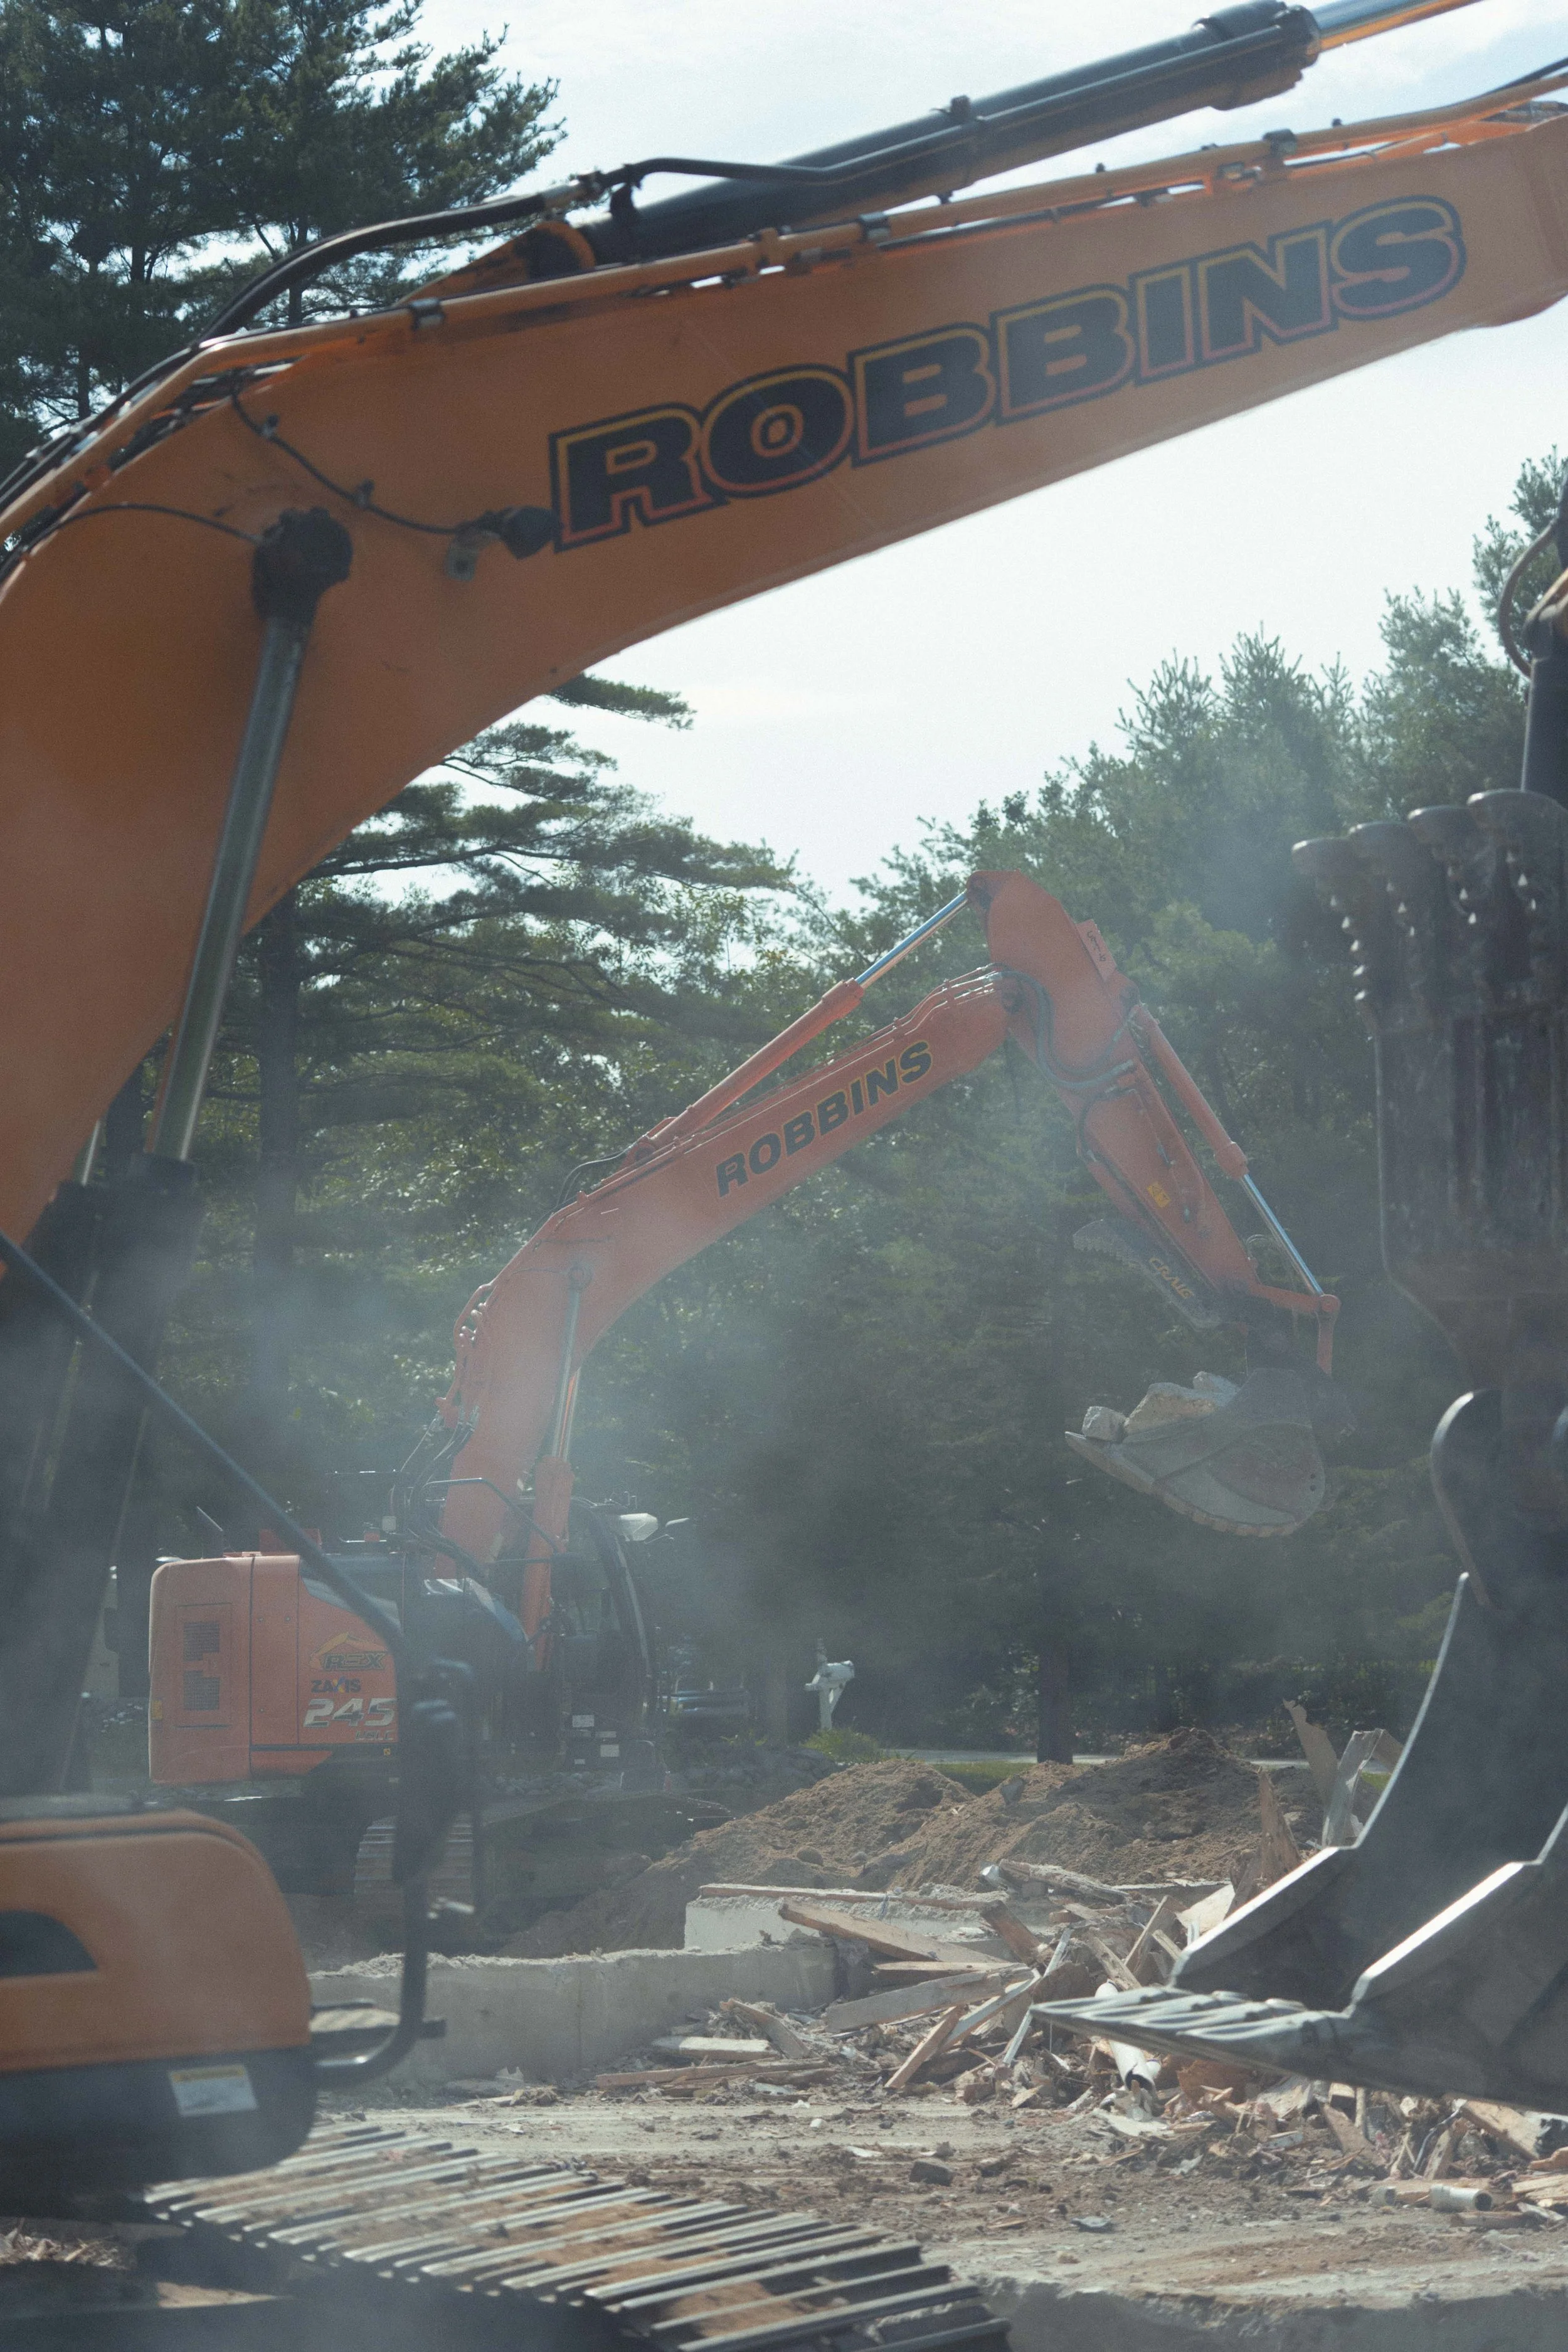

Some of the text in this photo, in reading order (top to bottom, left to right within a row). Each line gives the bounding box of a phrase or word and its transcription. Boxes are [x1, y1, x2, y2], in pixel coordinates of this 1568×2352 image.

[549, 194, 1466, 552] ROBBINS
[715, 1041, 933, 1197] ROBBINS
[1149, 1256, 1194, 1299] CRAIG
[322, 1651, 387, 1671] REX
[310, 1676, 362, 1693] ZAXIS
[303, 1697, 398, 1727] 245
